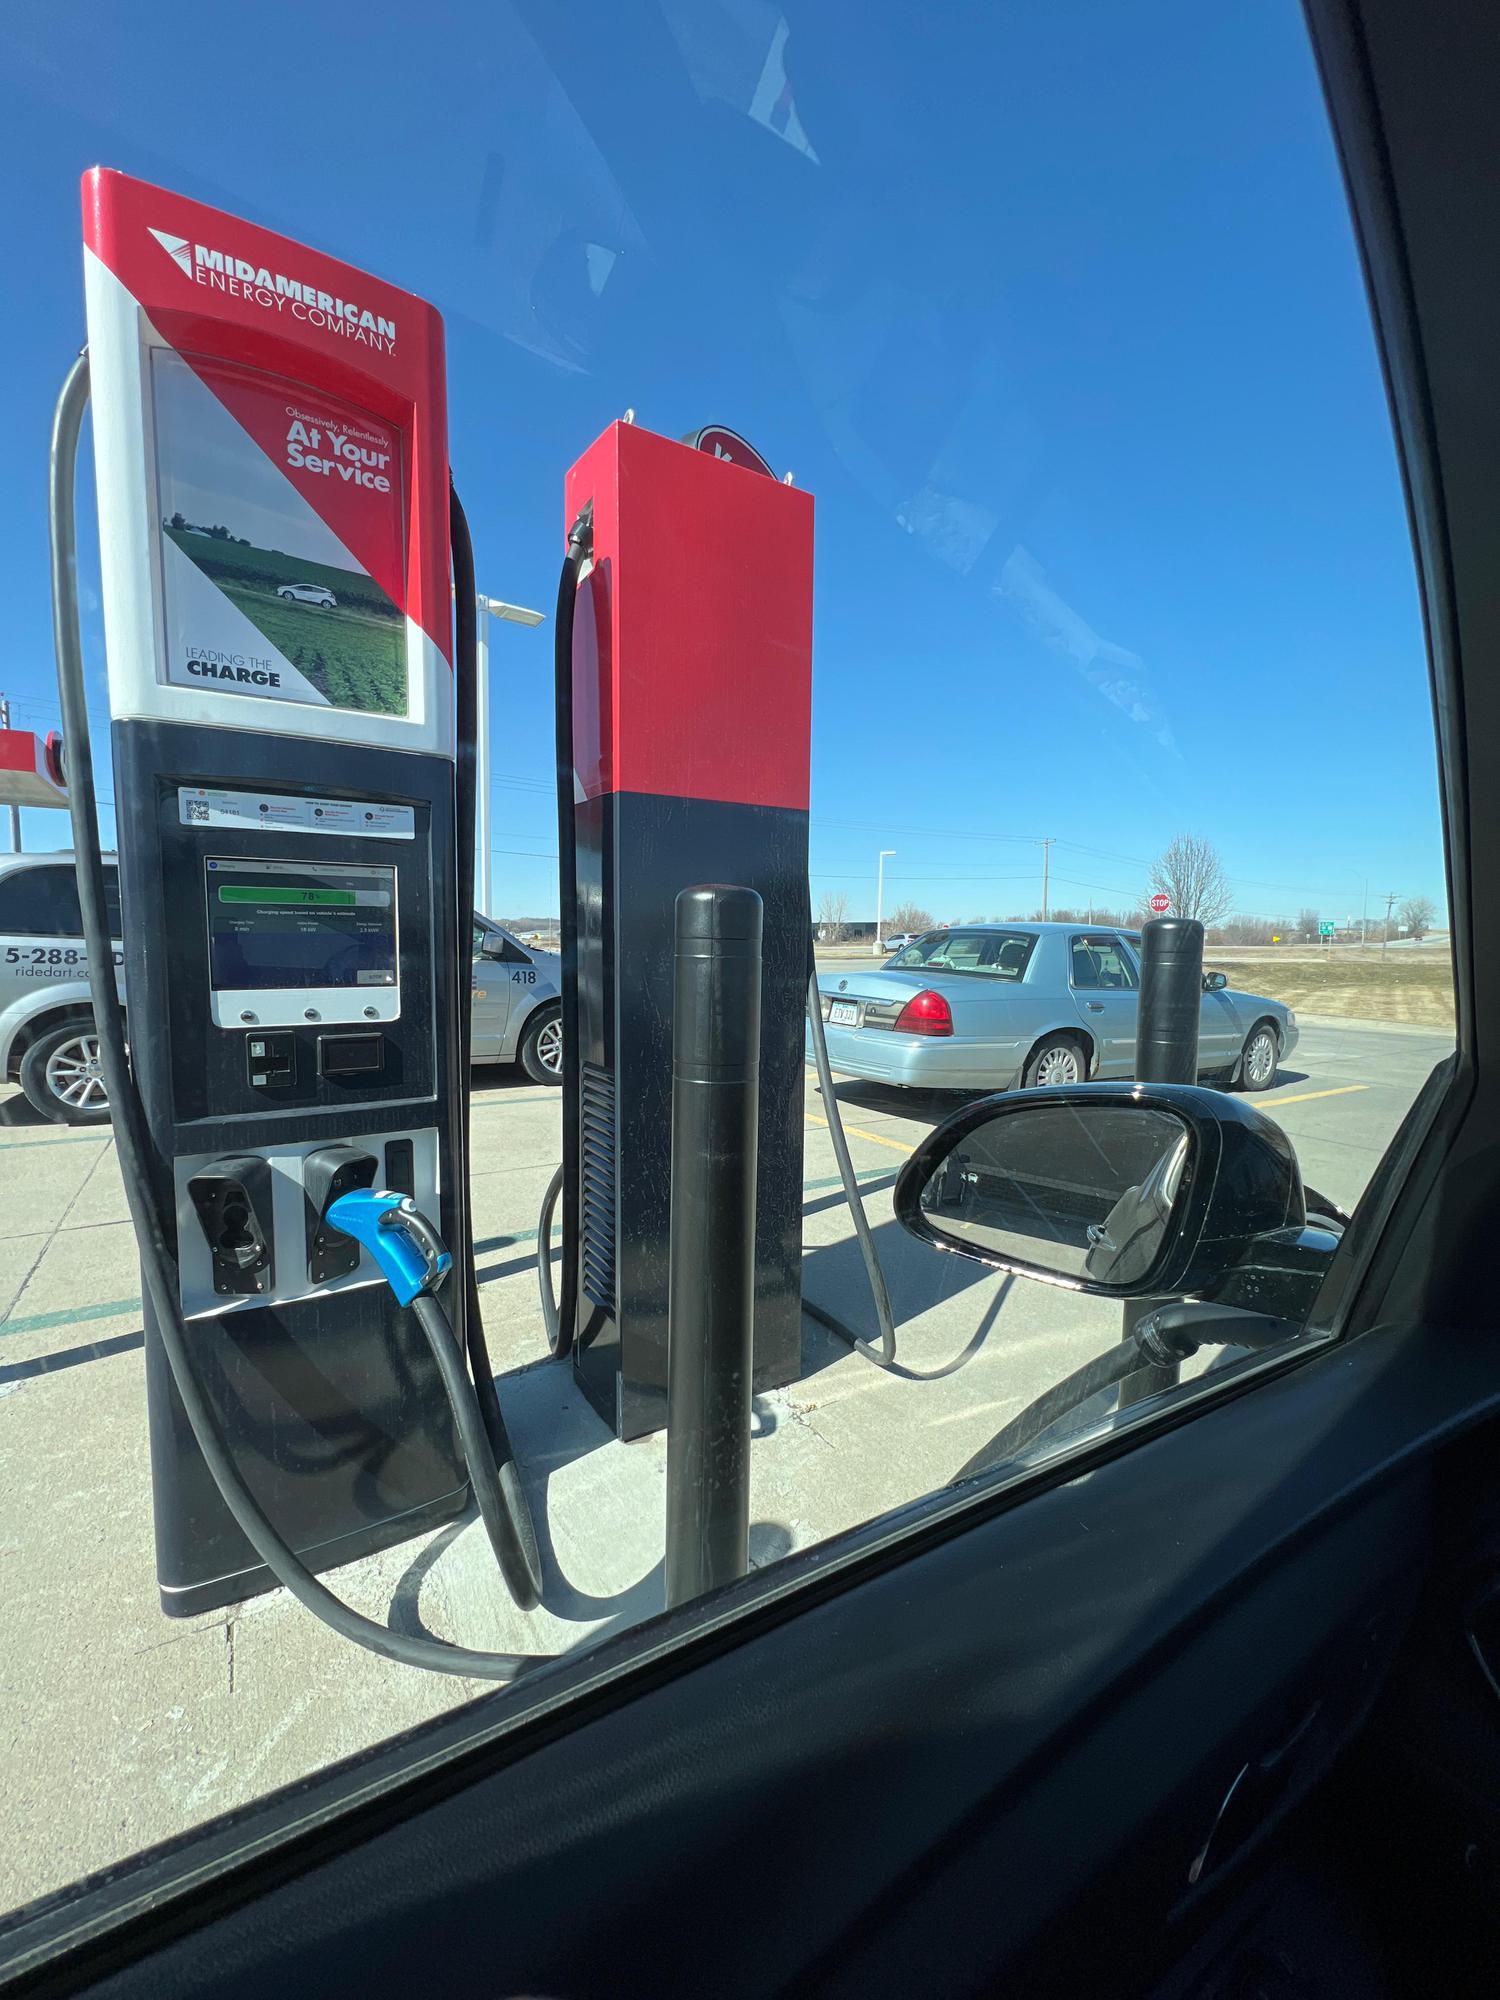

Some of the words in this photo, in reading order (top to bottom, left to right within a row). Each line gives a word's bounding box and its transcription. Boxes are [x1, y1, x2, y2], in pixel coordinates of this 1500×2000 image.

[195, 244, 395, 340] MIDAMERICAN
[196, 265, 286, 312] ENERGY
[291, 302, 396, 356] COMPANY
[285, 406, 340, 432] Obsessively,
[342, 424, 389, 449] Relentlessly
[286, 420, 321, 449] At
[325, 430, 390, 470] Your
[287, 443, 390, 492] Service
[186, 647, 245, 665] LEADING
[250, 656, 273, 671] THE
[187, 661, 280, 687] CHARGE
[1151, 899, 1169, 907] STOP
[511, 970, 537, 984] 418
